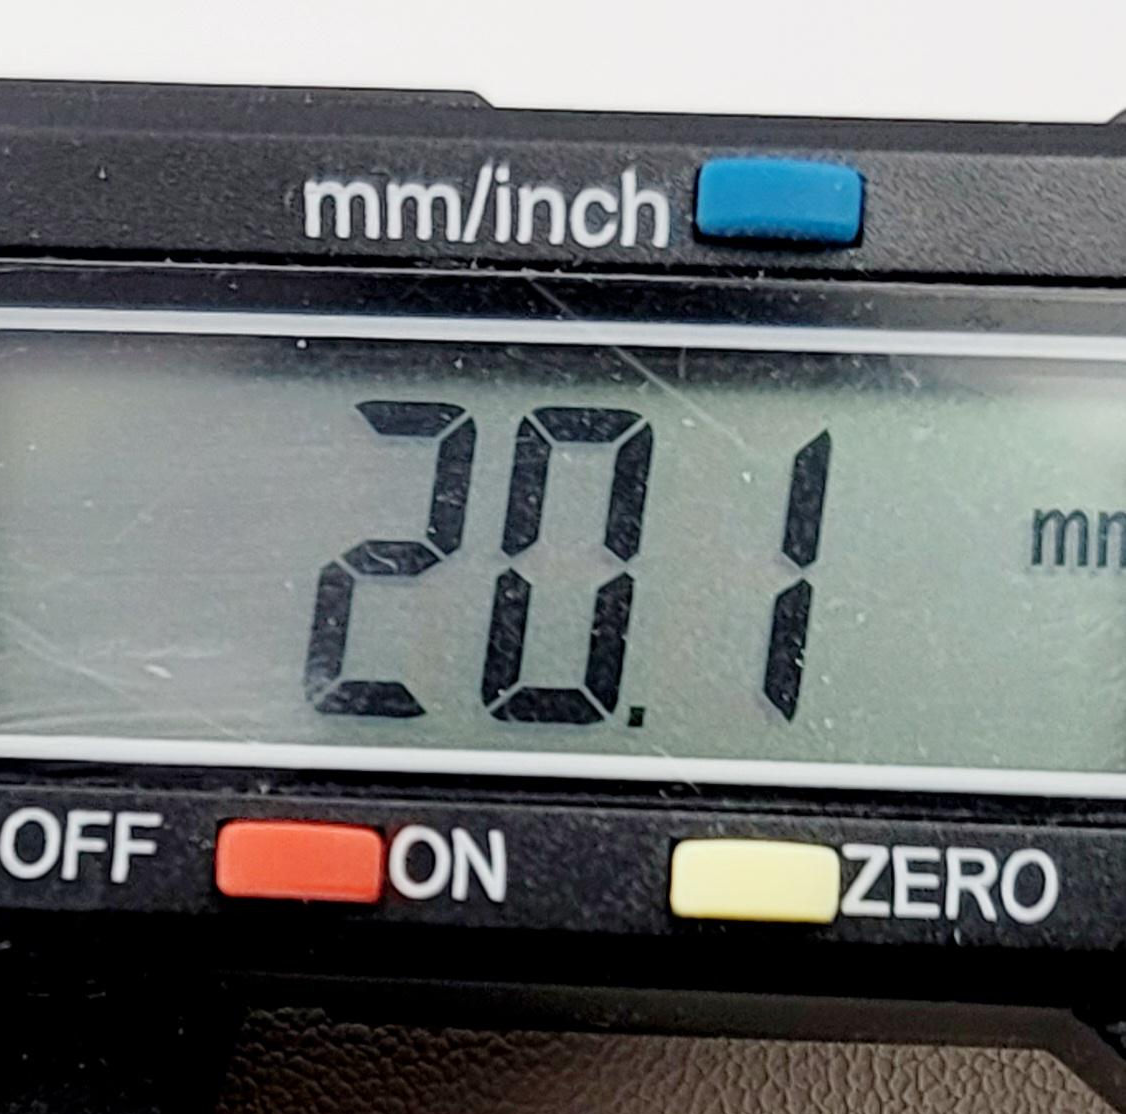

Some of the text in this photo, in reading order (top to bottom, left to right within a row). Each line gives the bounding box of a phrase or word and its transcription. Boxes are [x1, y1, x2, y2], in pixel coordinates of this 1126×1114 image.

[303, 163, 671, 250] mm/inch
[305, 399, 831, 728] 20.1
[388, 824, 508, 903] ON
[839, 842, 1061, 925] ZERO
